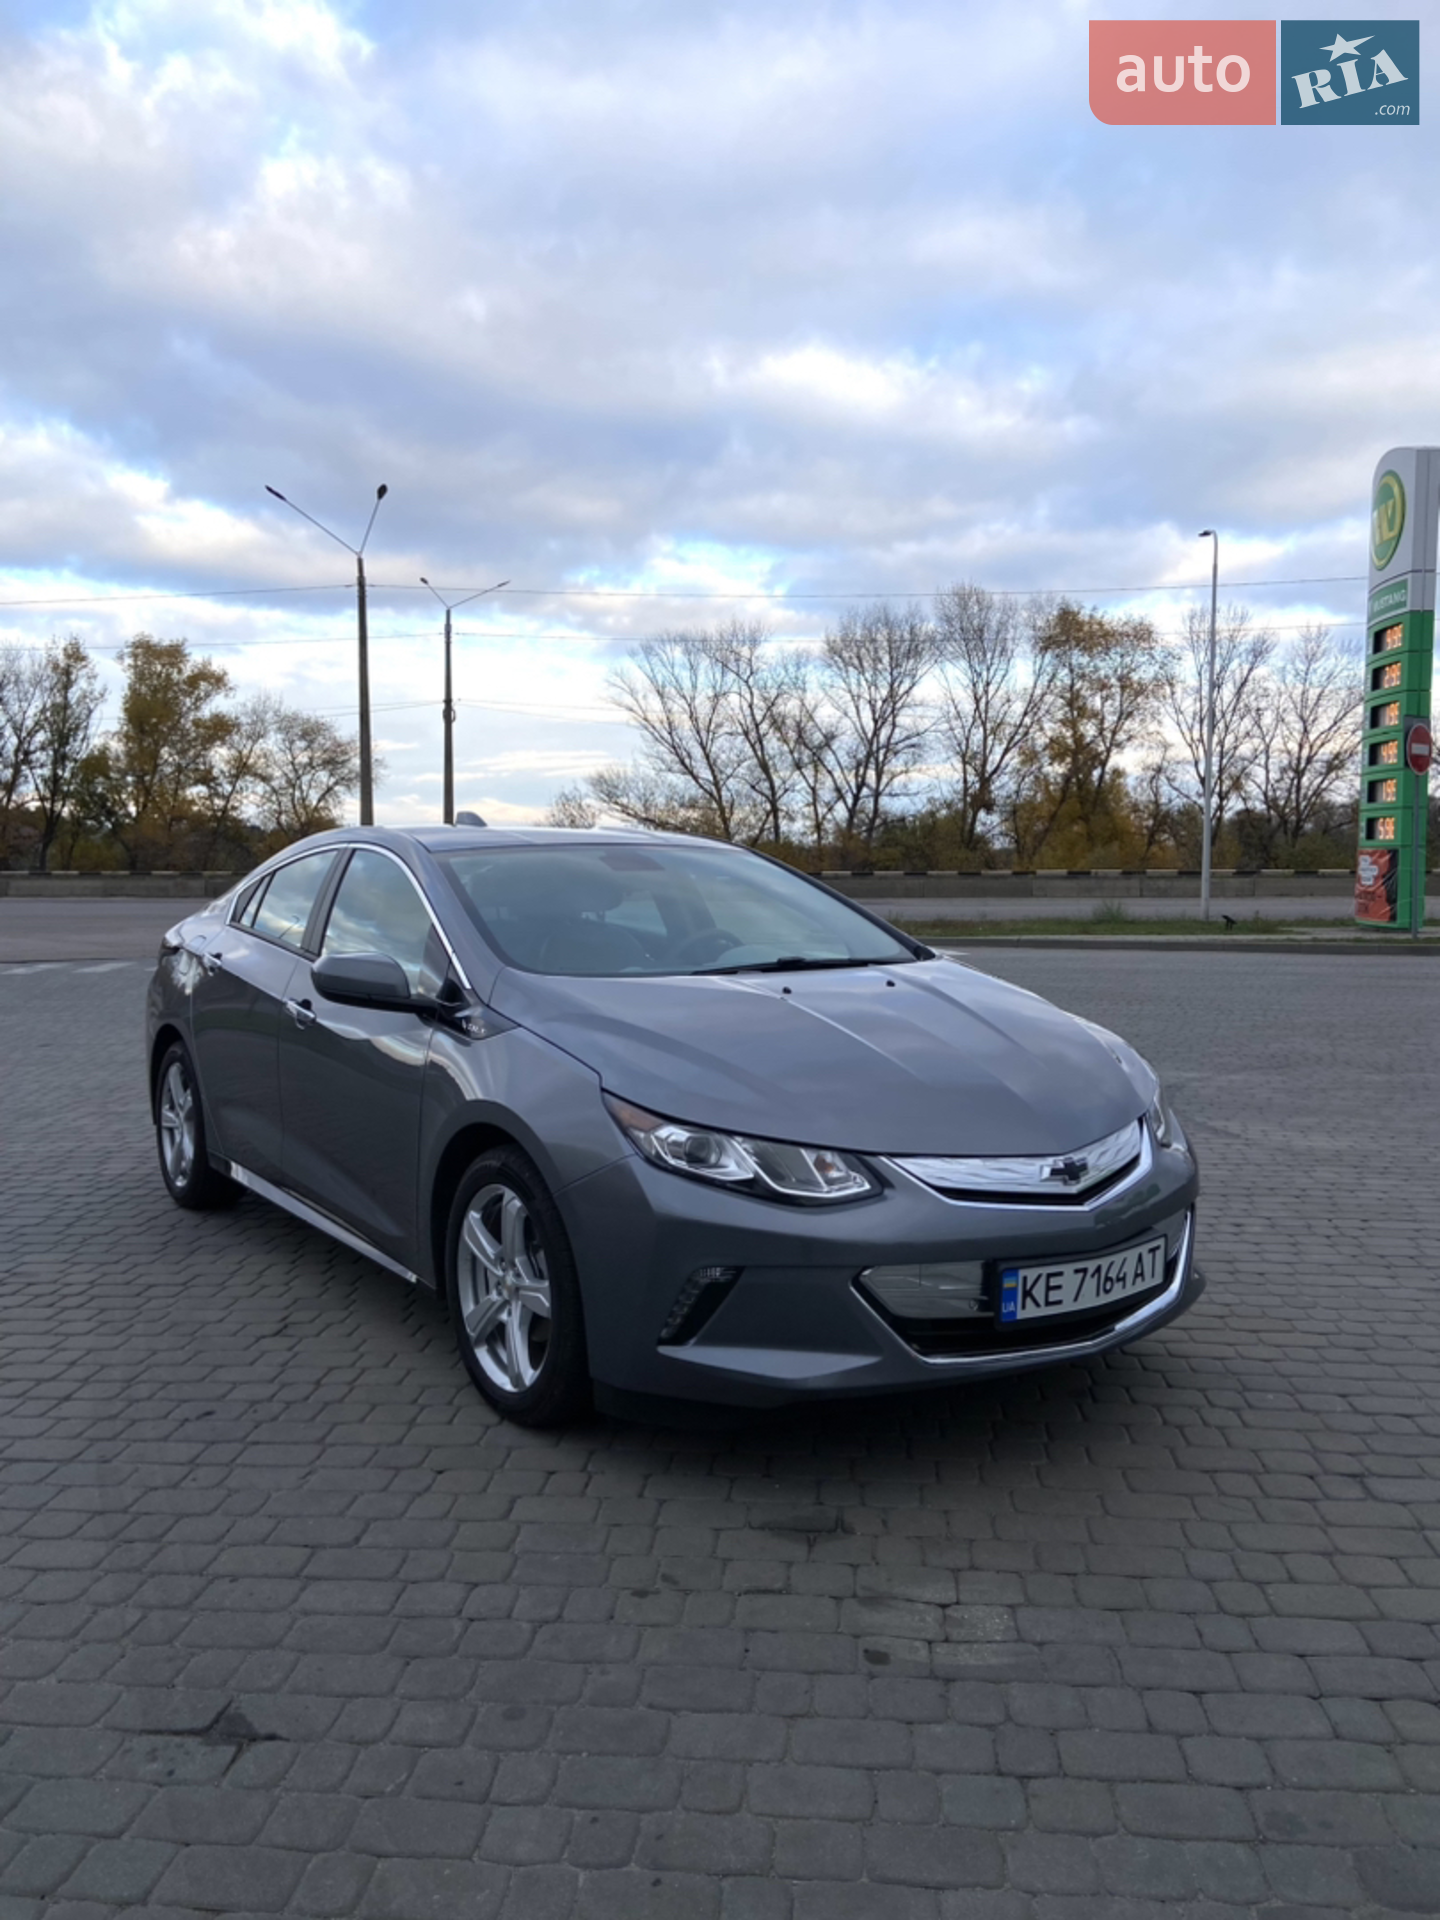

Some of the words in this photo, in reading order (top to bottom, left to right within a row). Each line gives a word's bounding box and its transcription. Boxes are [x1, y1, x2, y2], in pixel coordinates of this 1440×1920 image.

[1021, 1271, 1064, 1310] KE
[1073, 1257, 1127, 1302] 7164
[1132, 1245, 1162, 1285] AT
[1002, 1301, 1016, 1313] UA
